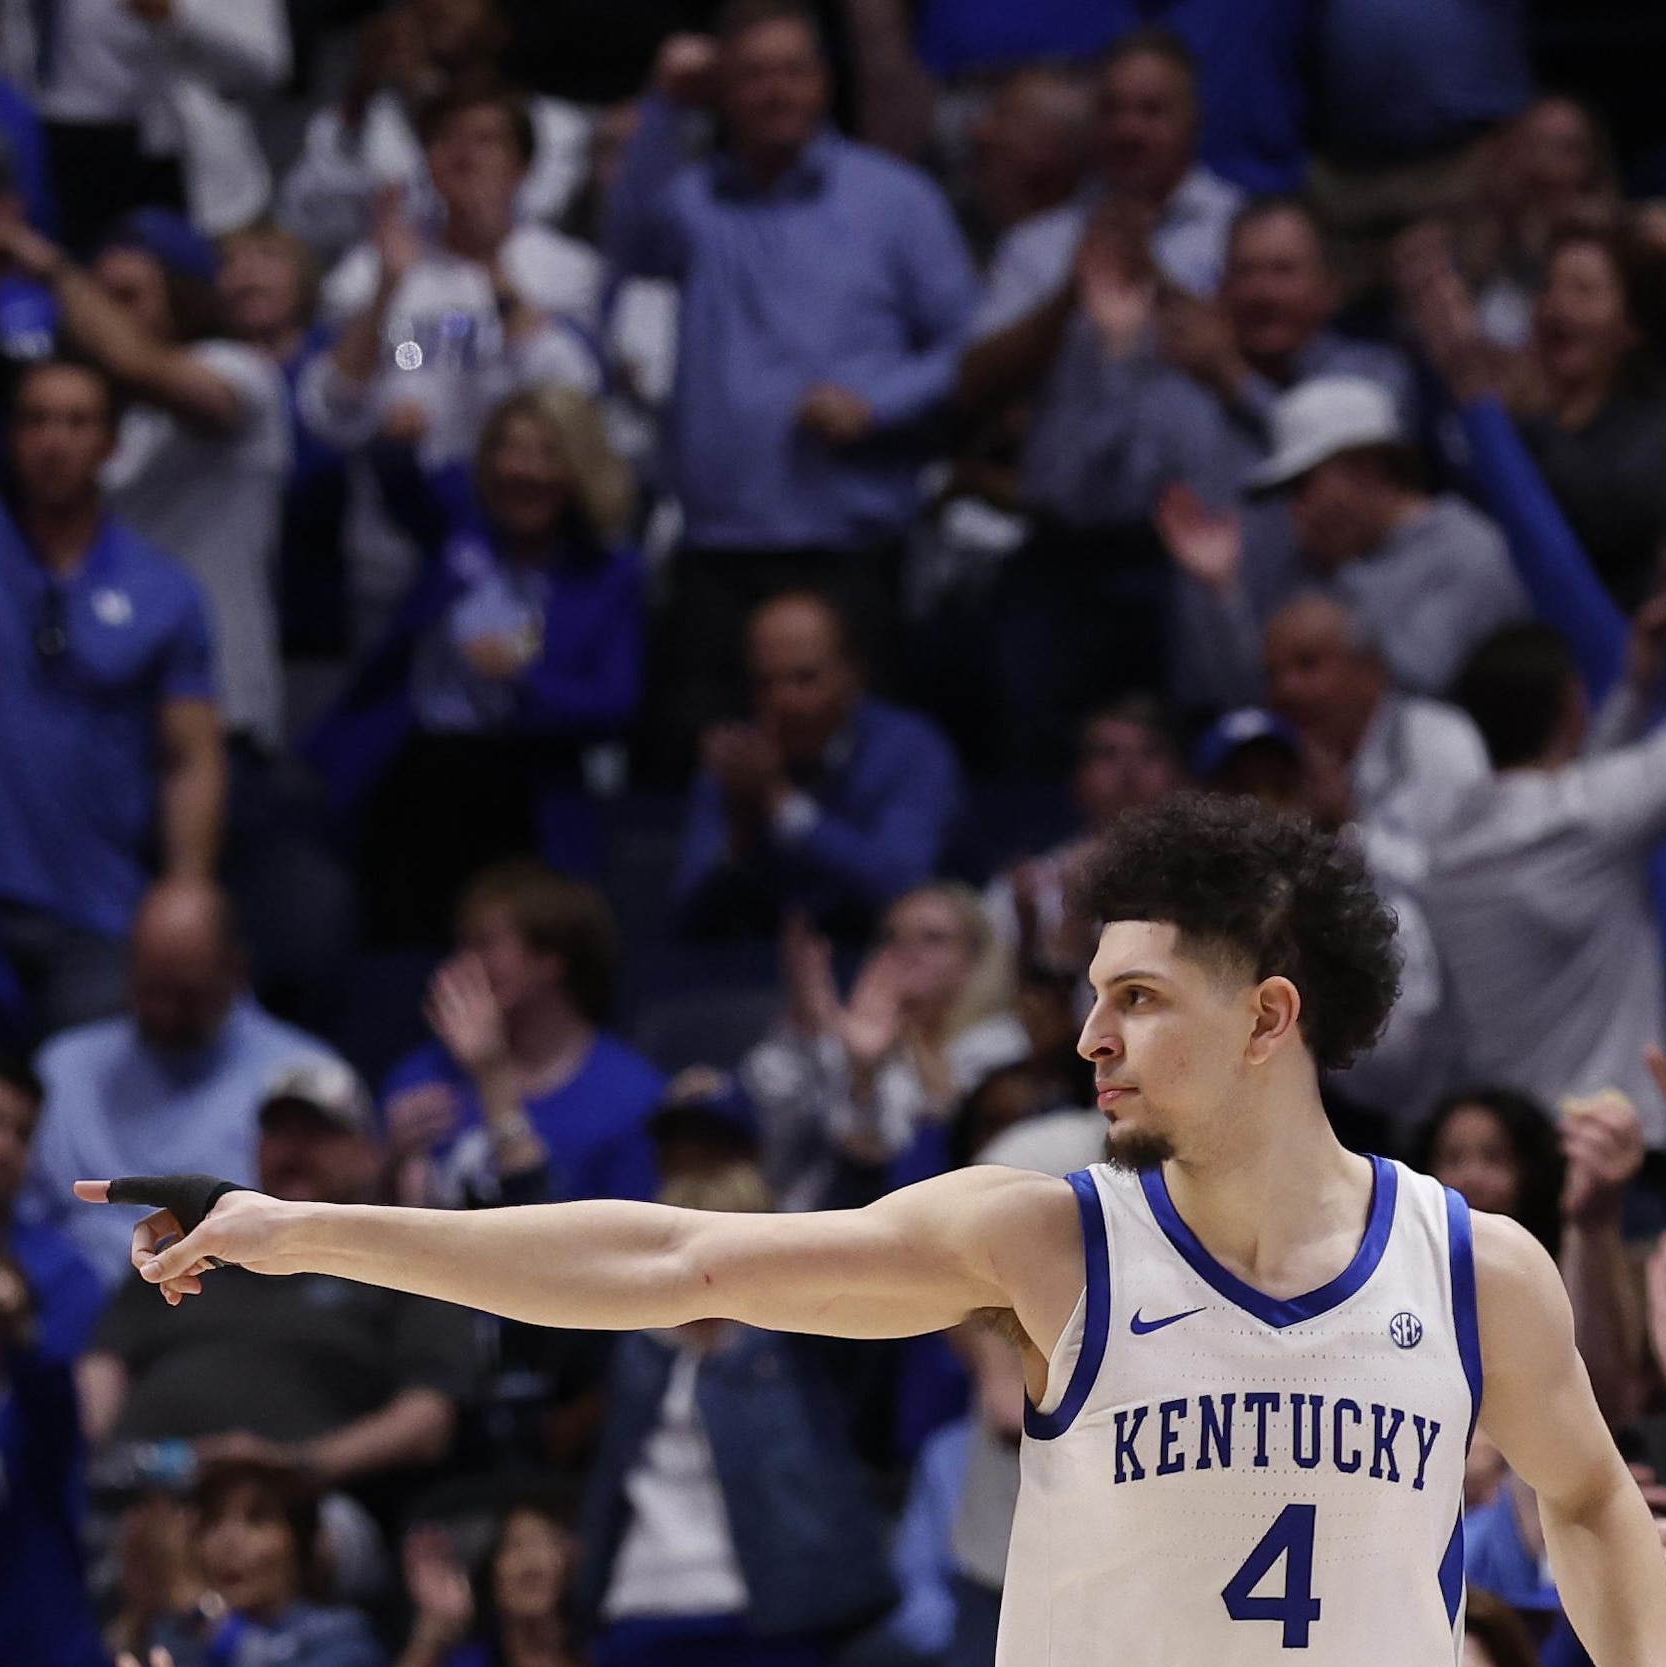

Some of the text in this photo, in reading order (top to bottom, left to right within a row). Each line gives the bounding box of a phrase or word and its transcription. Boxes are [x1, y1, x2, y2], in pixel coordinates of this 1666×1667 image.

[1390, 1312, 1422, 1349] SEC
[1113, 1392, 1441, 1491] KENTUCKY
[1220, 1503, 1321, 1650] 4
